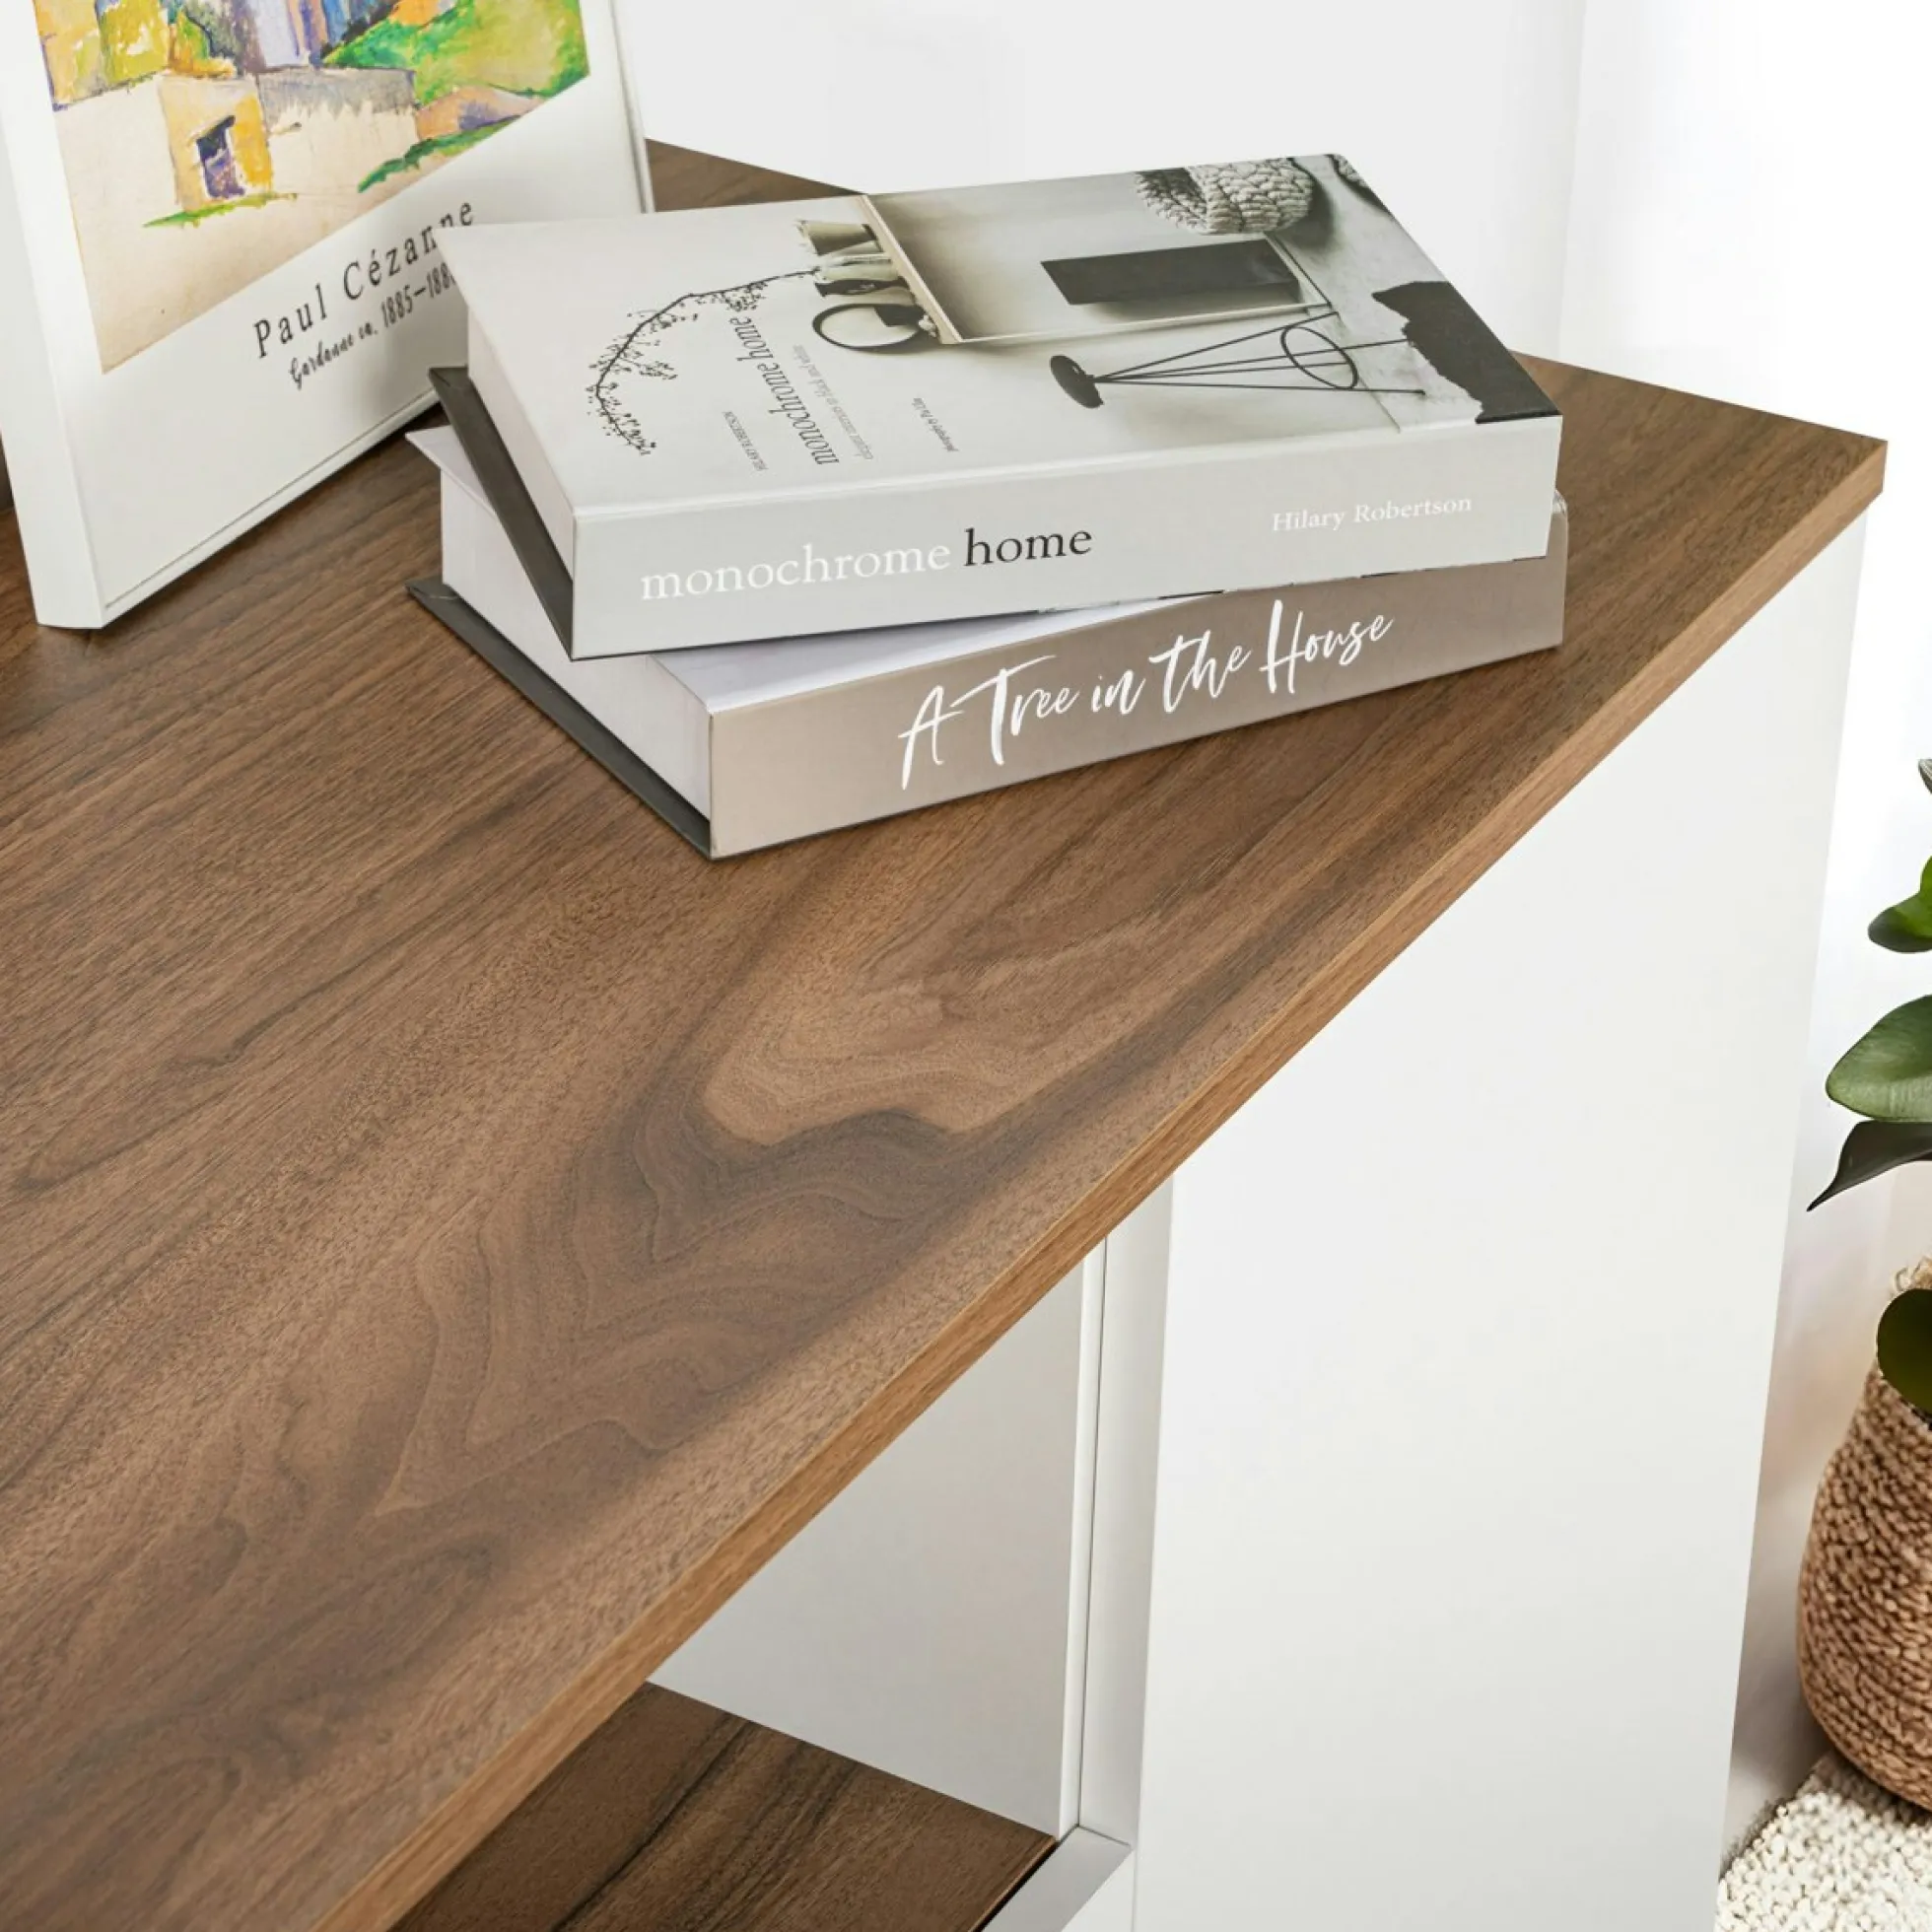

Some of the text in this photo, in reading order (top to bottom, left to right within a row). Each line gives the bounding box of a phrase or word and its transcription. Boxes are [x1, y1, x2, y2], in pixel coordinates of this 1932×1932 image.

[253, 283, 327, 358] Paul
[381, 262, 455, 327] 1885–188
[729, 316, 774, 361] home
[757, 363, 839, 464] monochrome
[1273, 498, 1472, 531] Hilary Robertson
[641, 527, 1092, 600] monochrome home
[898, 685, 963, 790] A
[949, 655, 1079, 765] Tree
[1091, 673, 1145, 715] in
[1260, 599, 1395, 694] House
